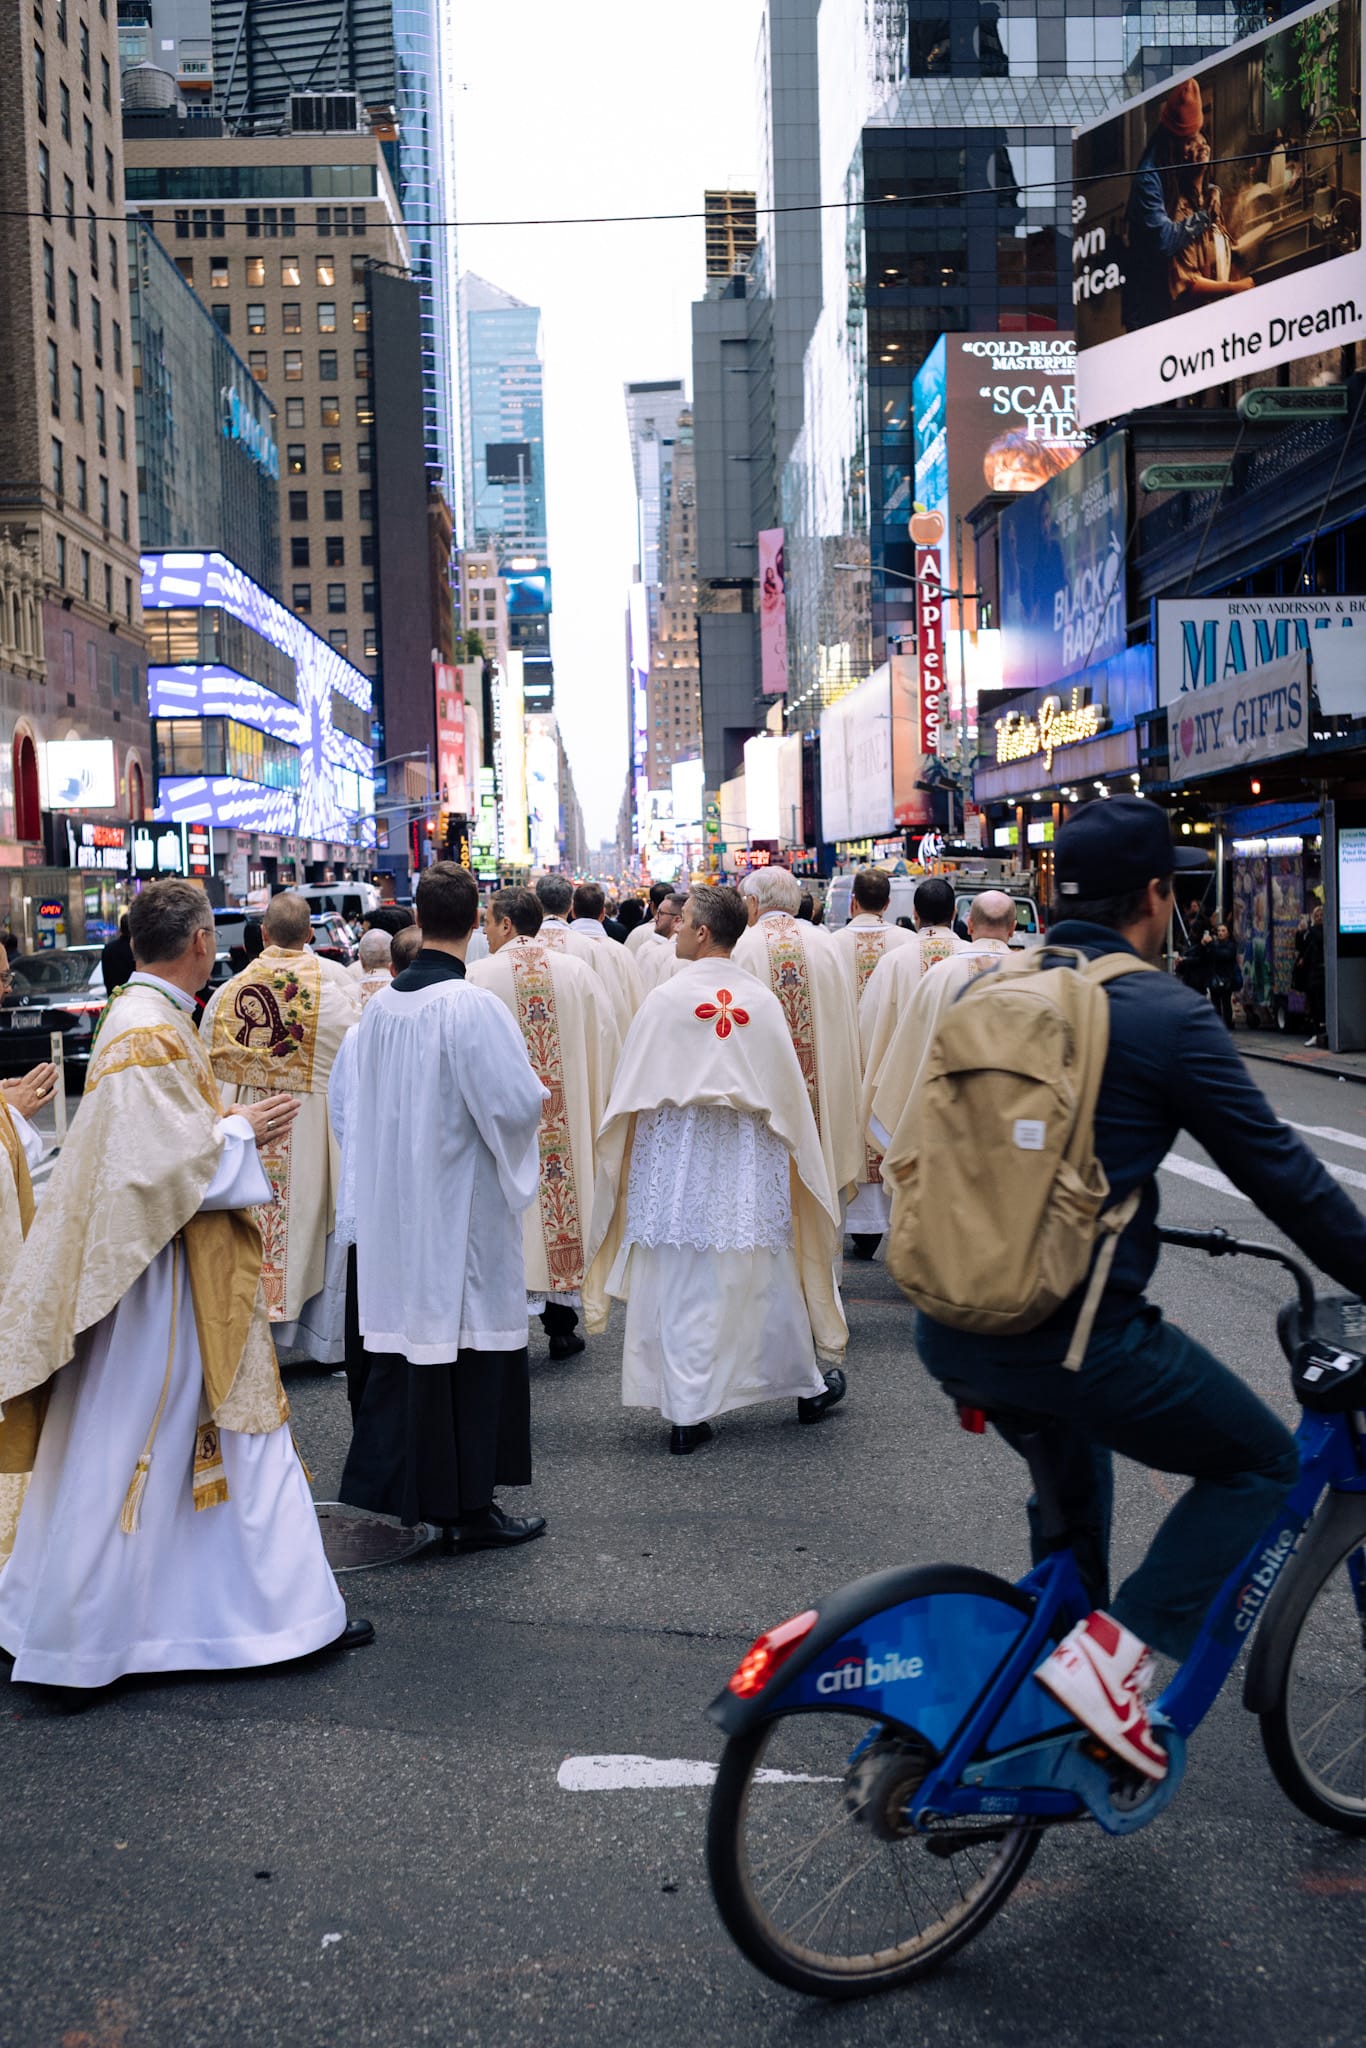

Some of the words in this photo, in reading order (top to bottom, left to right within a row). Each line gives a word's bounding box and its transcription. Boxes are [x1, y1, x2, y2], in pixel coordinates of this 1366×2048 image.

[1160, 348, 1214, 382] Own
[1221, 333, 1262, 363] the
[1269, 300, 1363, 348] Dream.
[1053, 561, 1104, 632] BLACK
[1062, 592, 1121, 667] RABBIT
[1228, 603, 1264, 615] BENNY
[1266, 602, 1331, 614] ANDERSSON
[1335, 601, 1345, 613] &
[1233, 671, 1303, 745] GIFTS
[40, 904, 61, 915] OPEN
